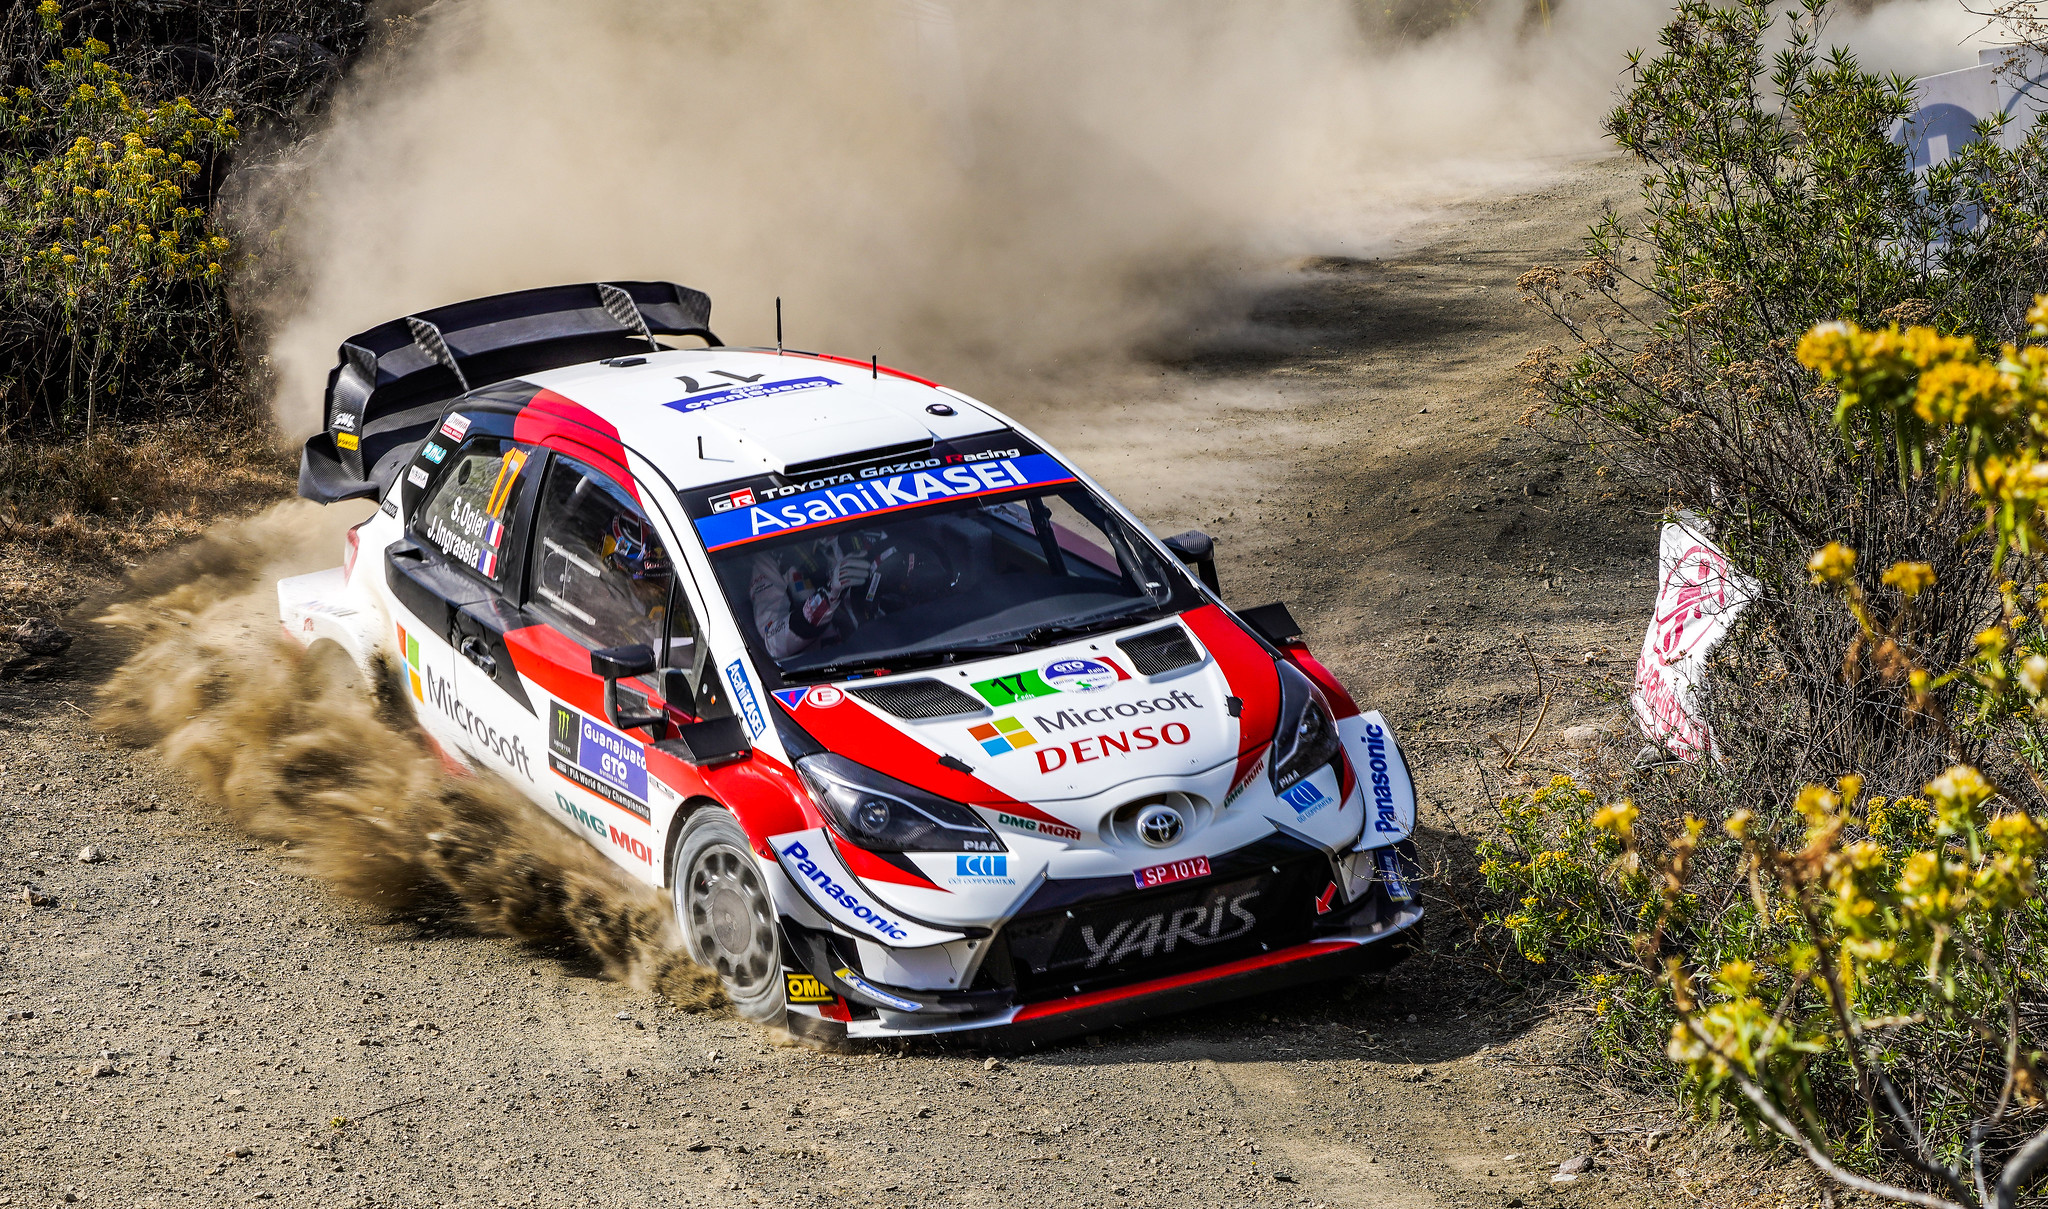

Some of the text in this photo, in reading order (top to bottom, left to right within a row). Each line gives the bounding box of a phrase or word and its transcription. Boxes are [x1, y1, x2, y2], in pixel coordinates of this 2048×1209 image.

[486, 447, 528, 518] 17
[713, 449, 1020, 512] GR TOYOTA GAZOO Racing
[451, 496, 488, 538] S.Ogier
[427, 515, 480, 569] J.Ingrassia
[991, 674, 1028, 695] 17
[1053, 661, 1085, 672] GTO
[427, 664, 535, 783] Microsoft
[1033, 690, 1203, 733] Microsoft
[584, 723, 647, 771] Guanajuato
[601, 753, 628, 780] GTO
[1034, 722, 1191, 775] DENSO
[570, 765, 580, 781] FIA
[580, 772, 596, 790] World
[597, 782, 612, 798] Rally
[612, 790, 650, 819] Championship
[1361, 723, 1401, 834] Panasonic
[555, 791, 608, 838] DMG
[998, 812, 1082, 841] DMG MORI
[963, 840, 1000, 851] PIAA
[782, 840, 908, 942] Panasonic
[1145, 858, 1208, 885] SP 1012
